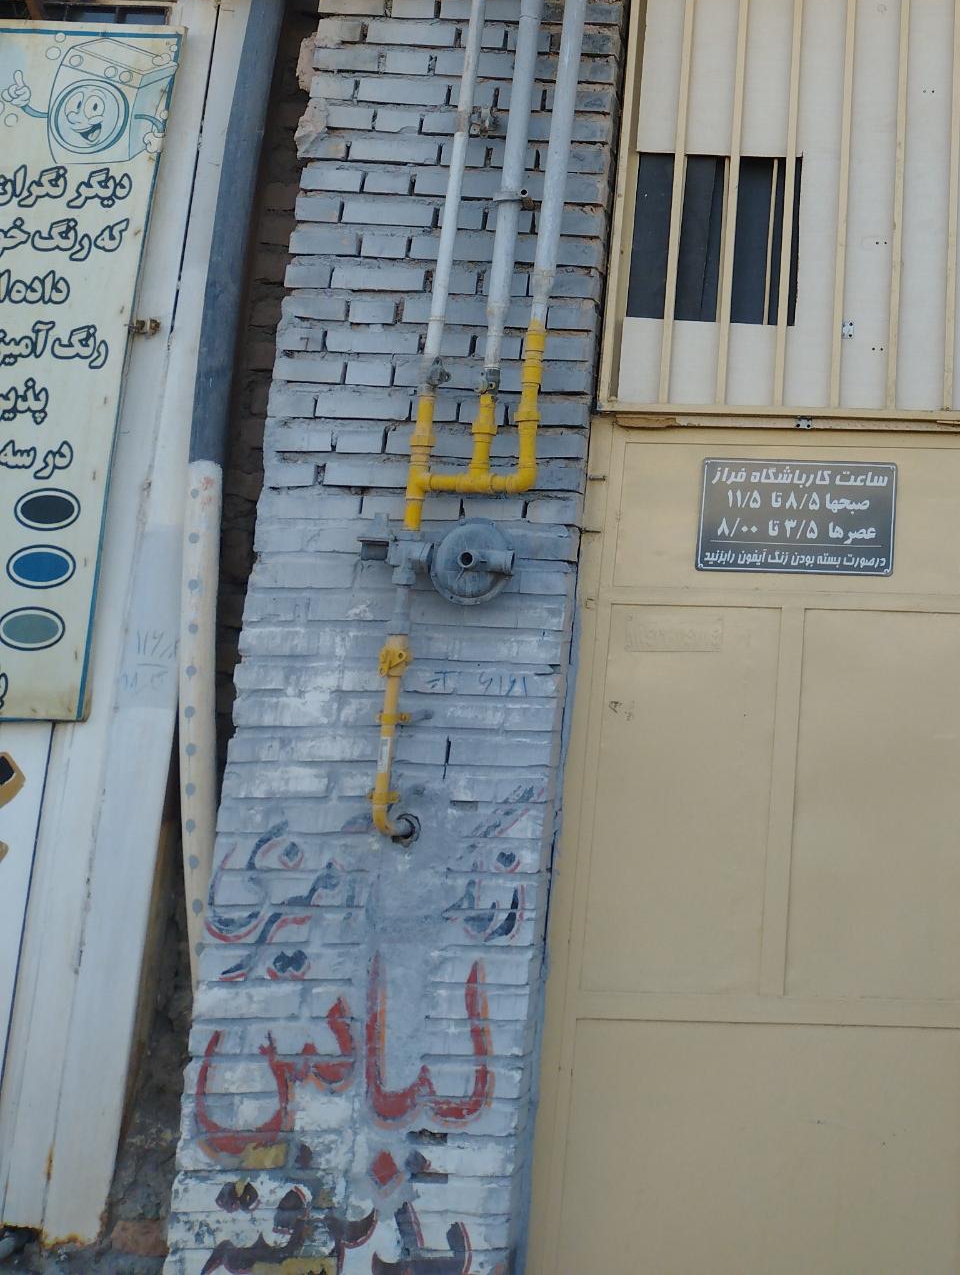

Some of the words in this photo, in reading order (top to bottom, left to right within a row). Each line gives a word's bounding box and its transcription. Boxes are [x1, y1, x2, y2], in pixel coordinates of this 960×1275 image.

[67, 168, 133, 208] دیگر
[31, 217, 92, 261] رنگ
[94, 218, 130, 252] که
[51, 324, 109, 369] رنگ
[33, 439, 74, 480] در
[711, 466, 747, 485] فراز
[835, 470, 888, 487] ساعت
[771, 491, 783, 508] تا
[825, 492, 870, 515] صبحها
[768, 519, 780, 537] تا
[738, 548, 768, 566] آیفون
[768, 551, 790, 566] زنگ
[790, 552, 815, 566] بودن
[816, 552, 842, 568] بسته
